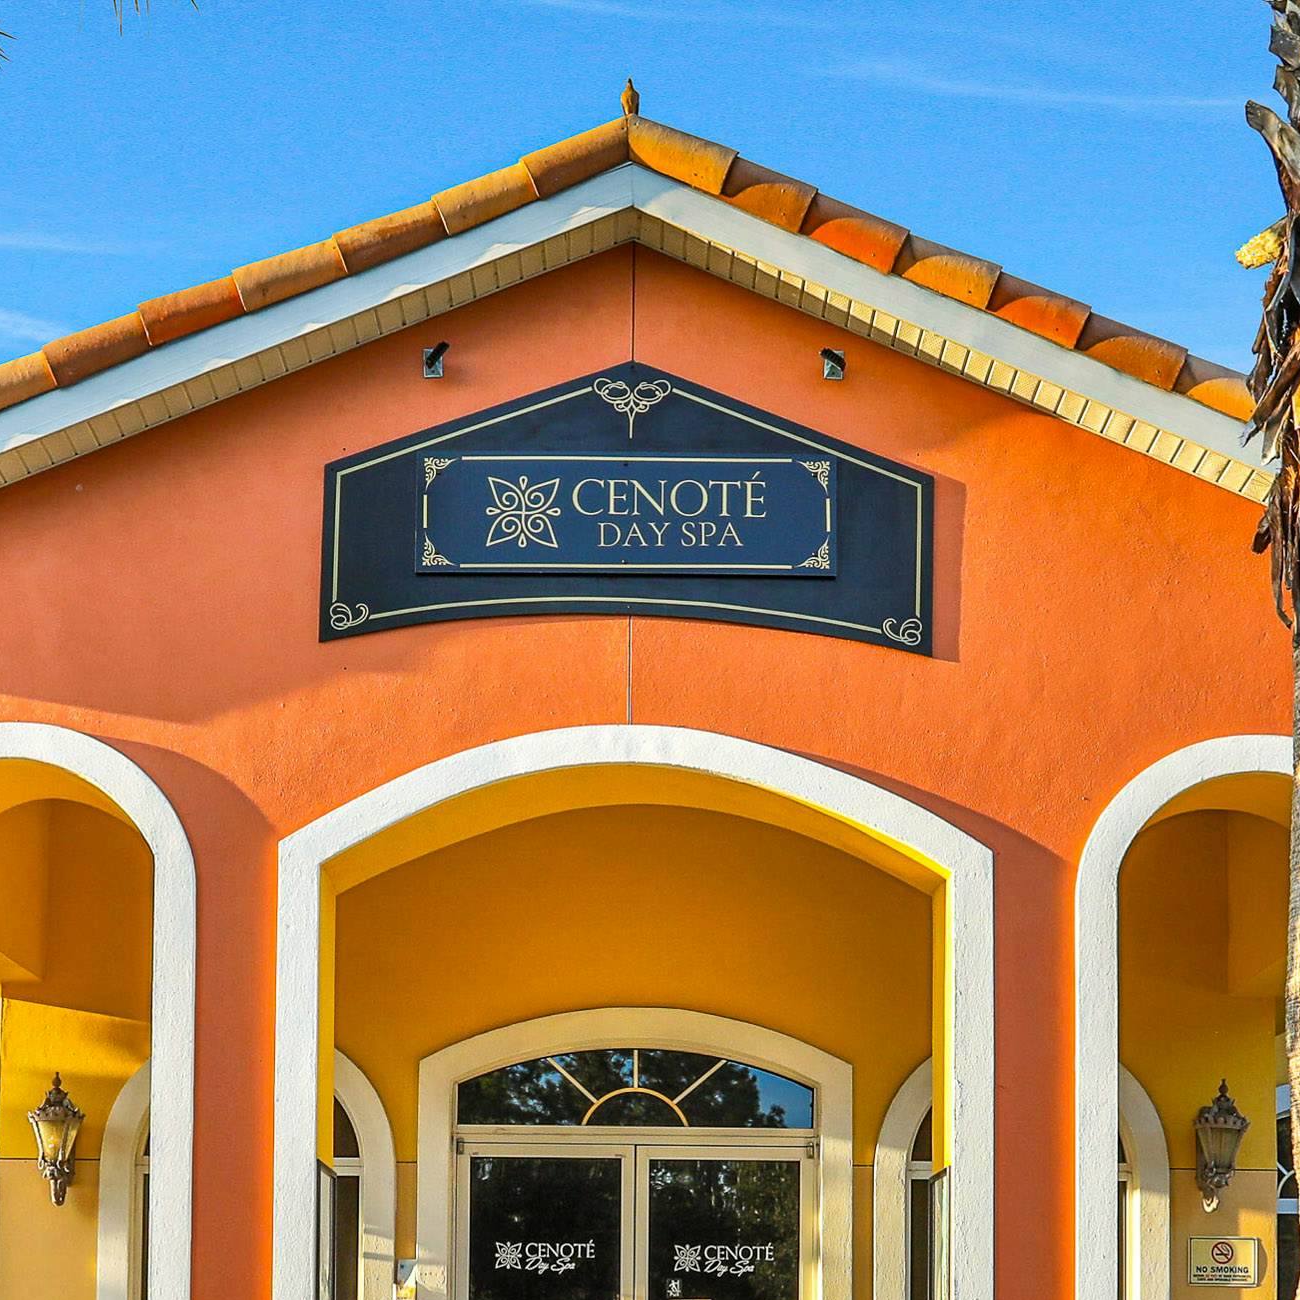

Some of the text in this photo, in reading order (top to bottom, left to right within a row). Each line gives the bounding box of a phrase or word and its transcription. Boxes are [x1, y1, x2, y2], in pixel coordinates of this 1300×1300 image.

[572, 471, 766, 518] CENOTÉ
[598, 522, 744, 547] DAY SPA
[525, 1239, 595, 1259] CENOTÉ
[704, 1242, 774, 1261] CENOTÉ
[525, 1257, 576, 1275] Day Spa
[703, 1260, 755, 1277] Day Spa
